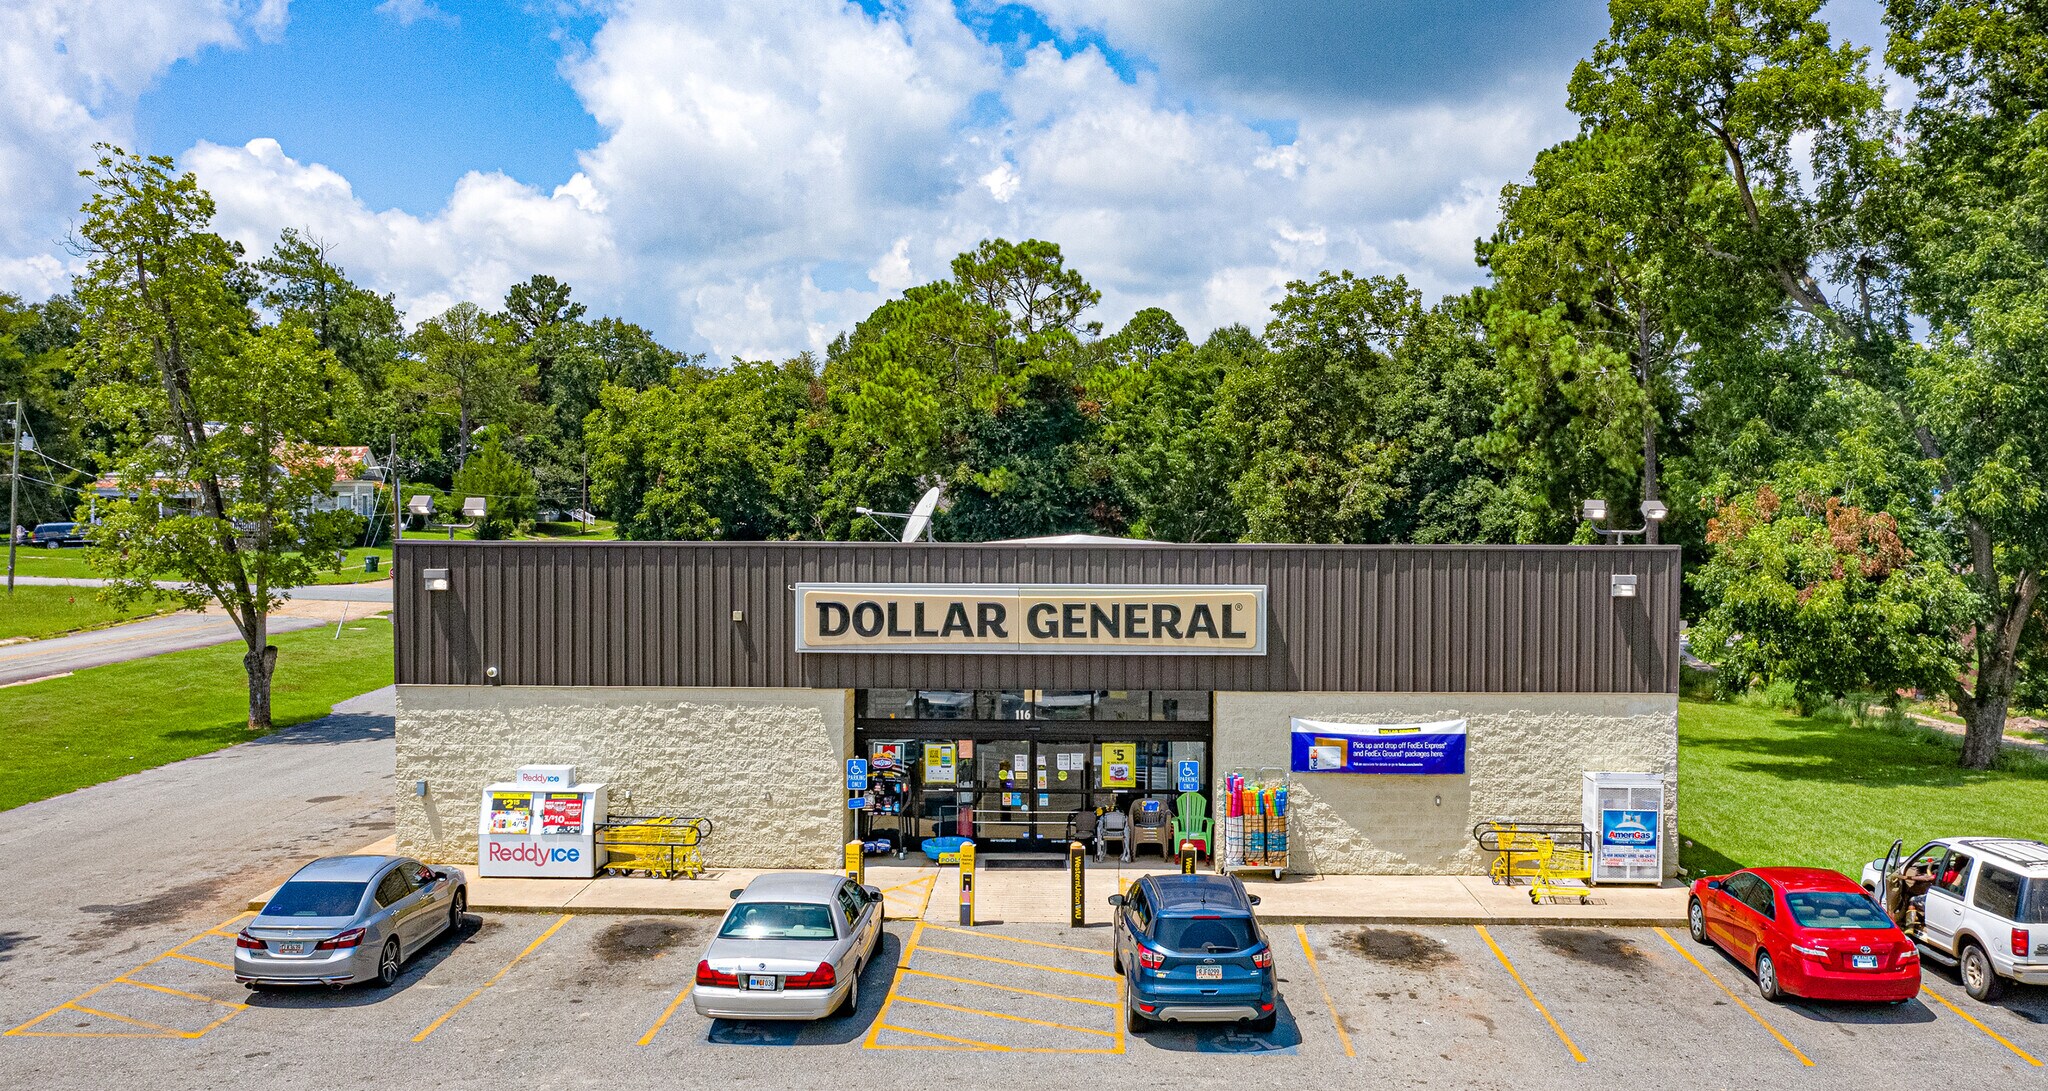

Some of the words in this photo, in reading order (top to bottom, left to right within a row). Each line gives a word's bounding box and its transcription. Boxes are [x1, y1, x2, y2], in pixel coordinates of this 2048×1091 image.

[816, 601, 1009, 639] DOLLAR
[1015, 709, 1031, 720] 116
[1385, 742, 1397, 750] drop
[1113, 749, 1125, 761] $5
[1404, 751, 1430, 759] packages
[1608, 831, 1651, 839] AmeriGas
